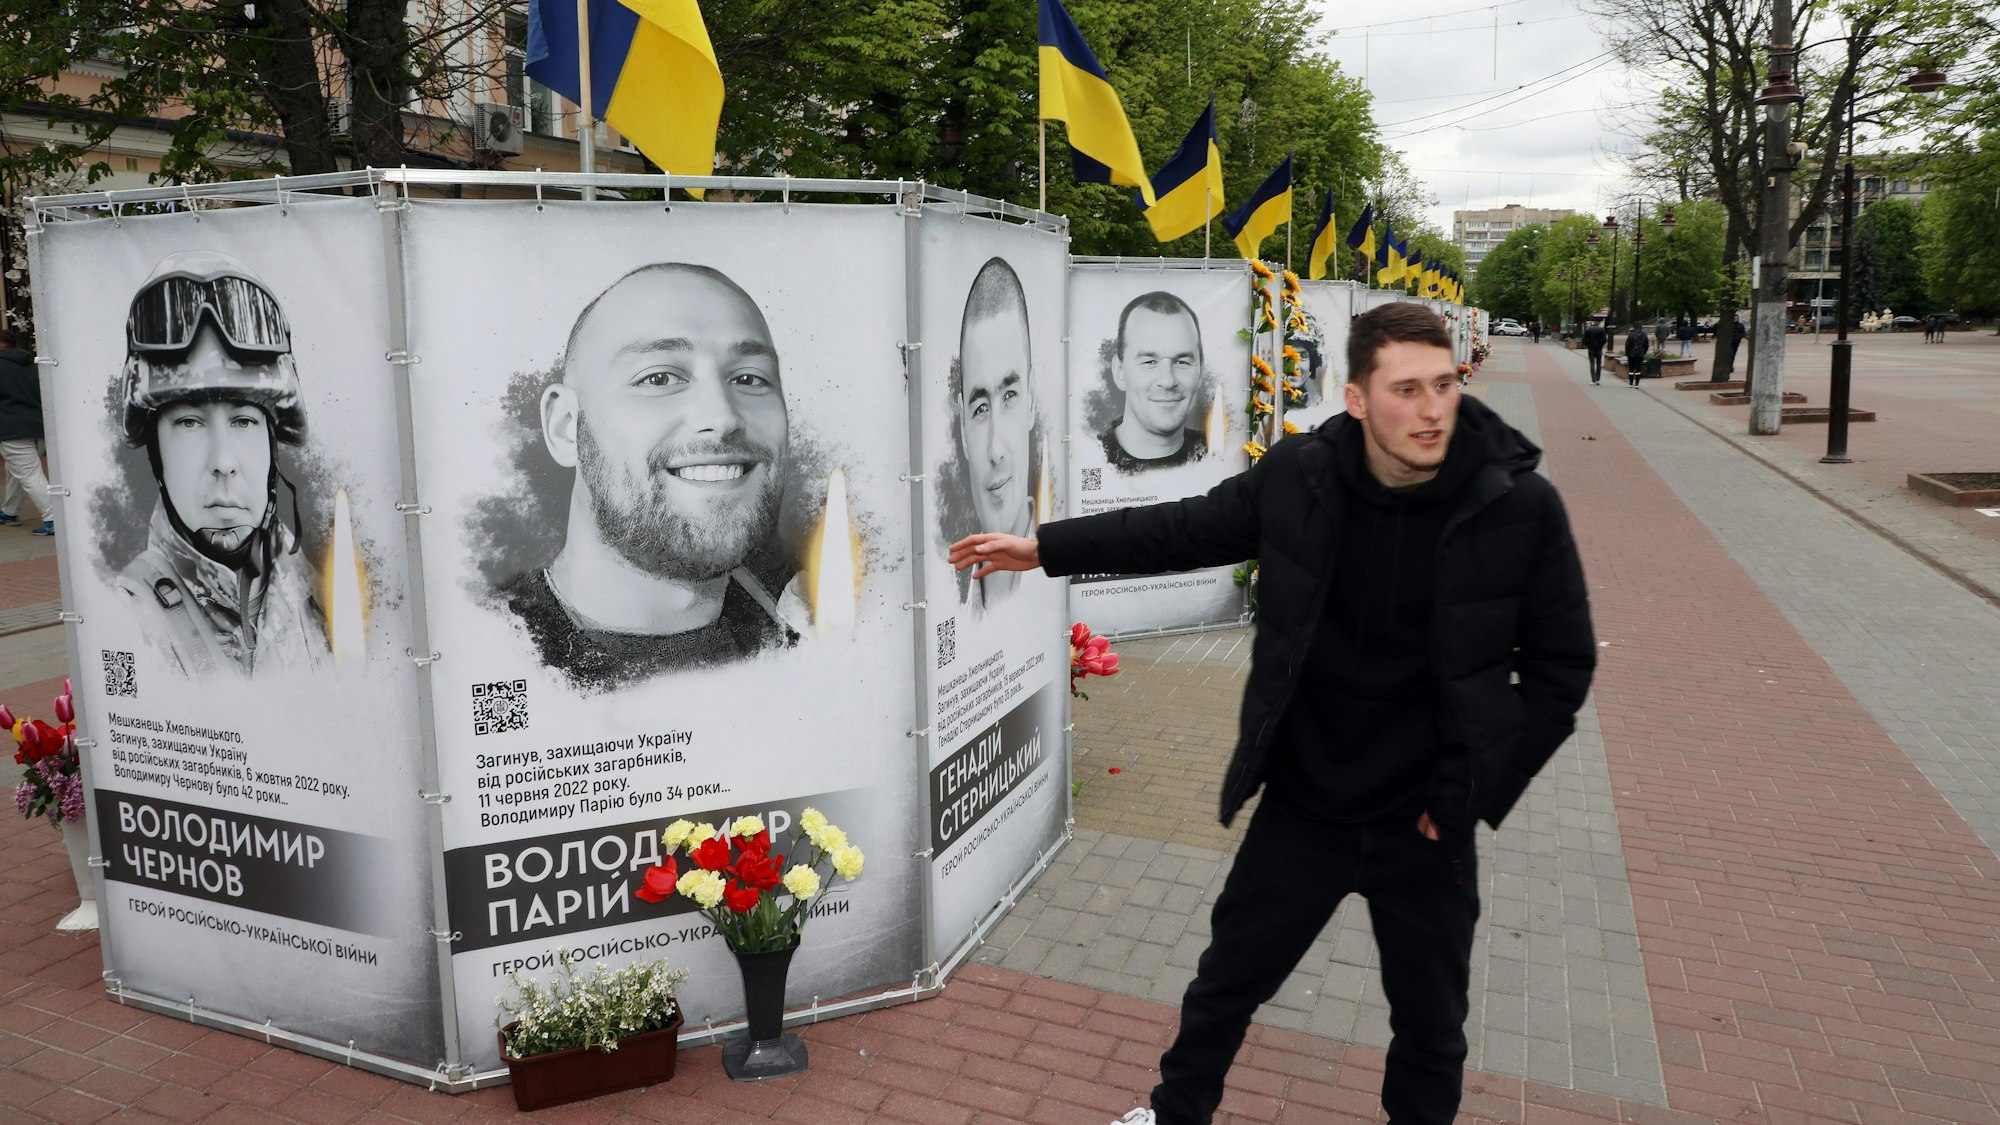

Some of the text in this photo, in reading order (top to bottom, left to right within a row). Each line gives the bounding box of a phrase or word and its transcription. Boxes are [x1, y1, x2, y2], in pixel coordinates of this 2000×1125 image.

[1081, 588, 1104, 597] ГЕРОЙ
[1196, 578, 1216, 586] ВІЙНИ
[108, 712, 244, 744] Мешканець Хмельницького.
[110, 729, 247, 765] Загинув, захищаючи Україну
[475, 729, 693, 769] Загинув, захищаючи Україну
[937, 717, 946, 732] від
[112, 747, 350, 800] від російських загарбників, 6 жовтня 2022 року.
[114, 763, 289, 805] Володимиру Чернову було 42 роки...
[478, 748, 686, 789] від російських загарбників,
[939, 721, 1002, 802] ГЕНАДІЙ
[939, 726, 1041, 841] СТЕРНИЦЬКИЙ
[478, 777, 630, 808] 11 червня 2022 року.
[480, 782, 731, 828] Володимиру Парію було 34 роки...
[118, 801, 325, 868] ВОЛОДИМИР
[484, 810, 791, 889] ВОЛОДР
[941, 847, 963, 879] ГЕРОЙ
[1033, 771, 1049, 795] ВІЙНИ
[122, 843, 244, 897] ЧЕРНОВ
[488, 871, 630, 936] ПАРІЙ
[128, 898, 378, 966] ГЕРОЙ РОСІЙСЬКО-УКРАЇНСЬКОЇ ВІЙНИ
[492, 949, 554, 977] ГЕРОЙ
[809, 899, 850, 919] ІЙНИ
